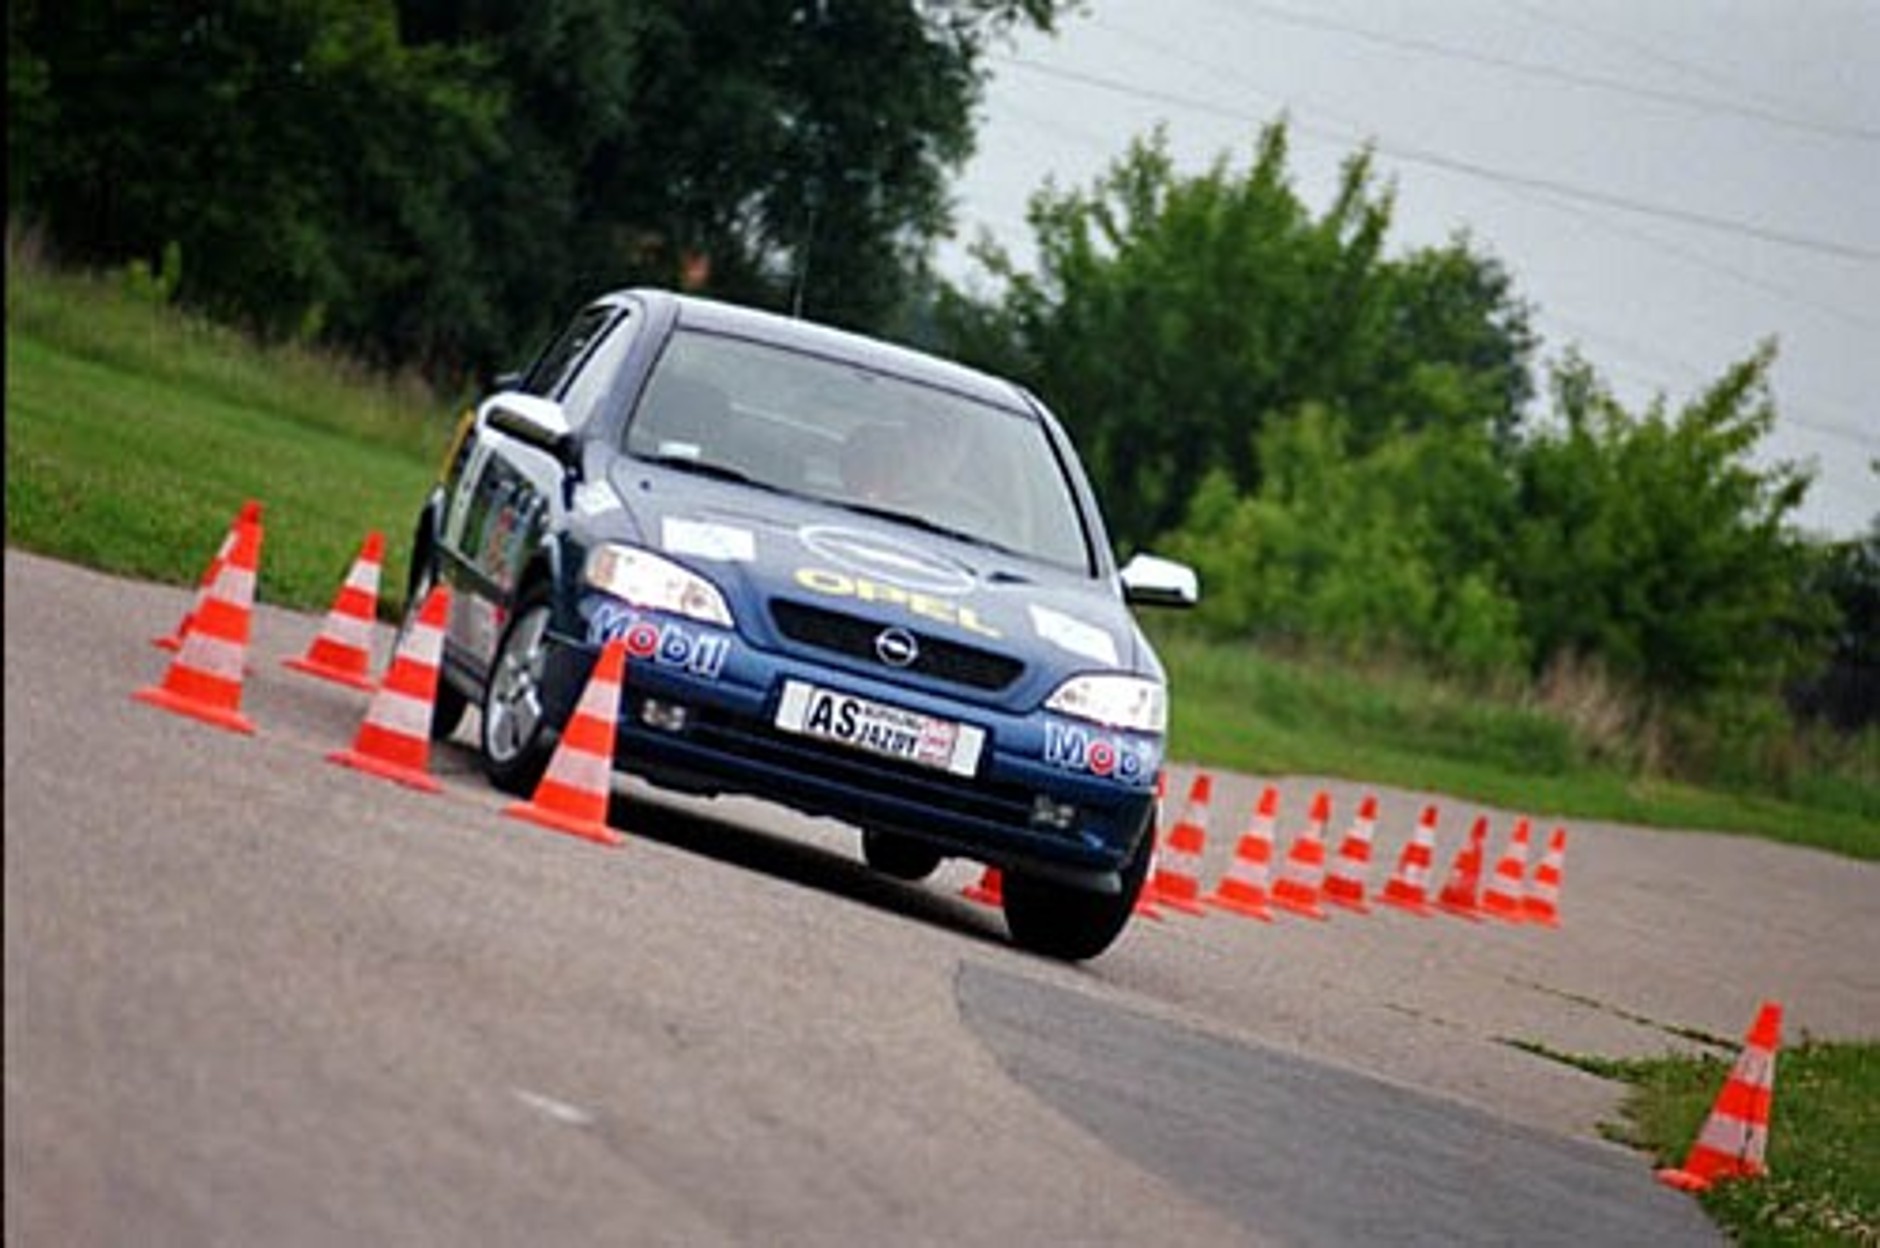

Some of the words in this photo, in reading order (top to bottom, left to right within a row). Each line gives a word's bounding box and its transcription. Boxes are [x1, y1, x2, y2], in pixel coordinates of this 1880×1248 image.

[795, 568, 1002, 639] OPEL
[588, 601, 732, 679] Mobil
[808, 694, 860, 739] AS
